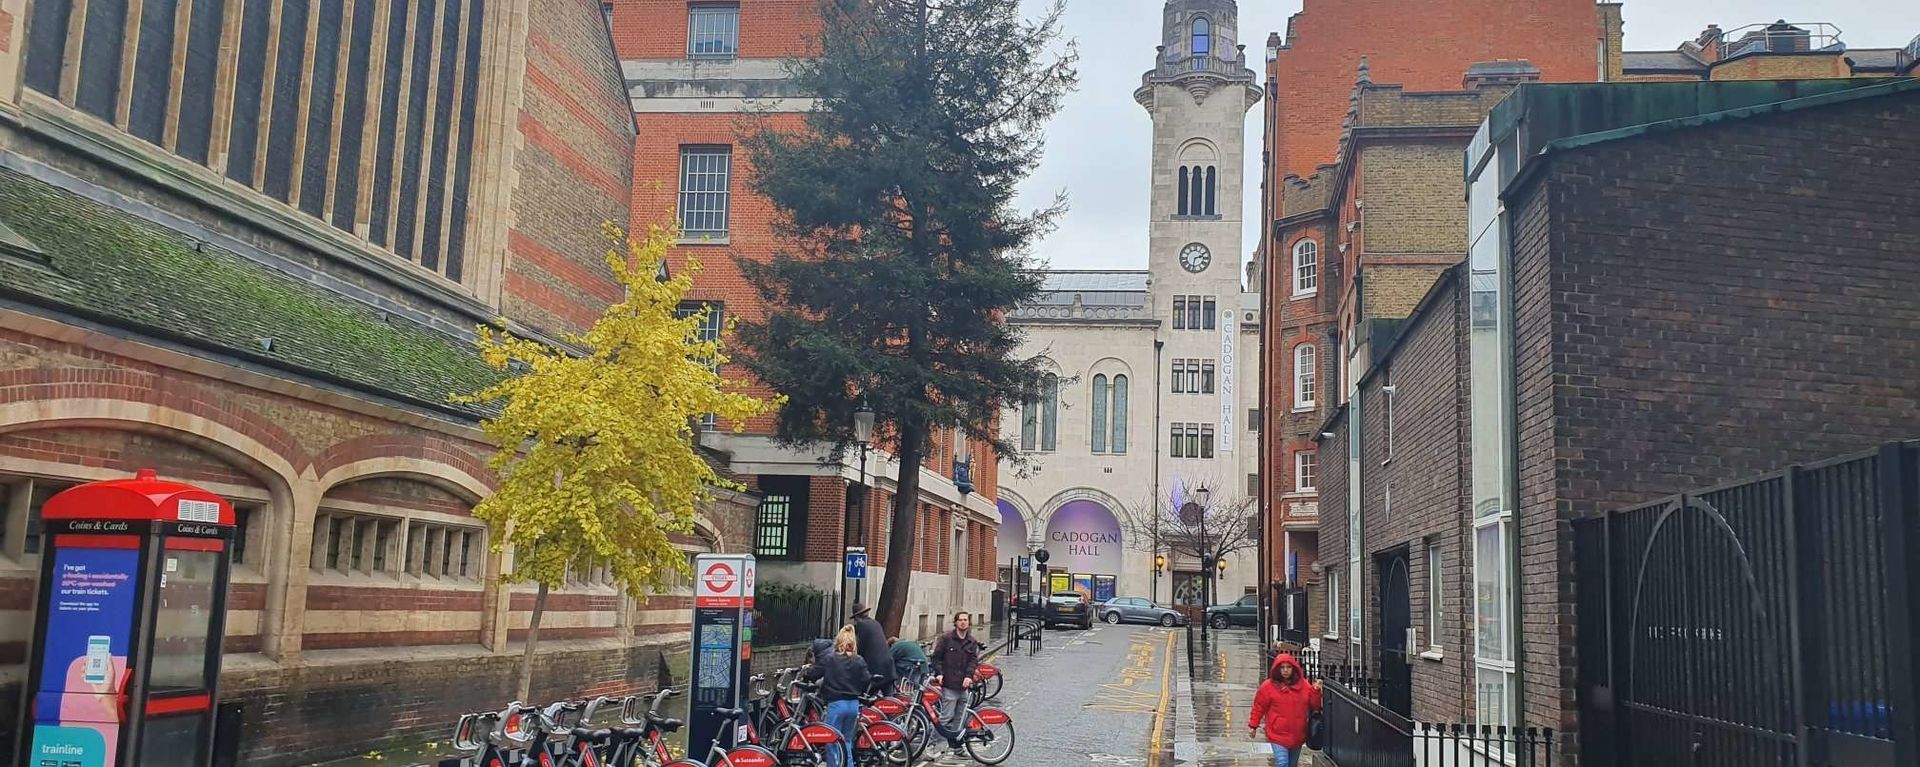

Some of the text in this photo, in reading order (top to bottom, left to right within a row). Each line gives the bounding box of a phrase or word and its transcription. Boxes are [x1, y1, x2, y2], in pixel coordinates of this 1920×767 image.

[1223, 324, 1232, 444] CADOGAN HALL
[69, 520, 128, 531] Coins & Cards
[1052, 531, 1118, 543] CADOGAN
[1069, 545, 1100, 556] HALL
[41, 744, 84, 755] trainline
